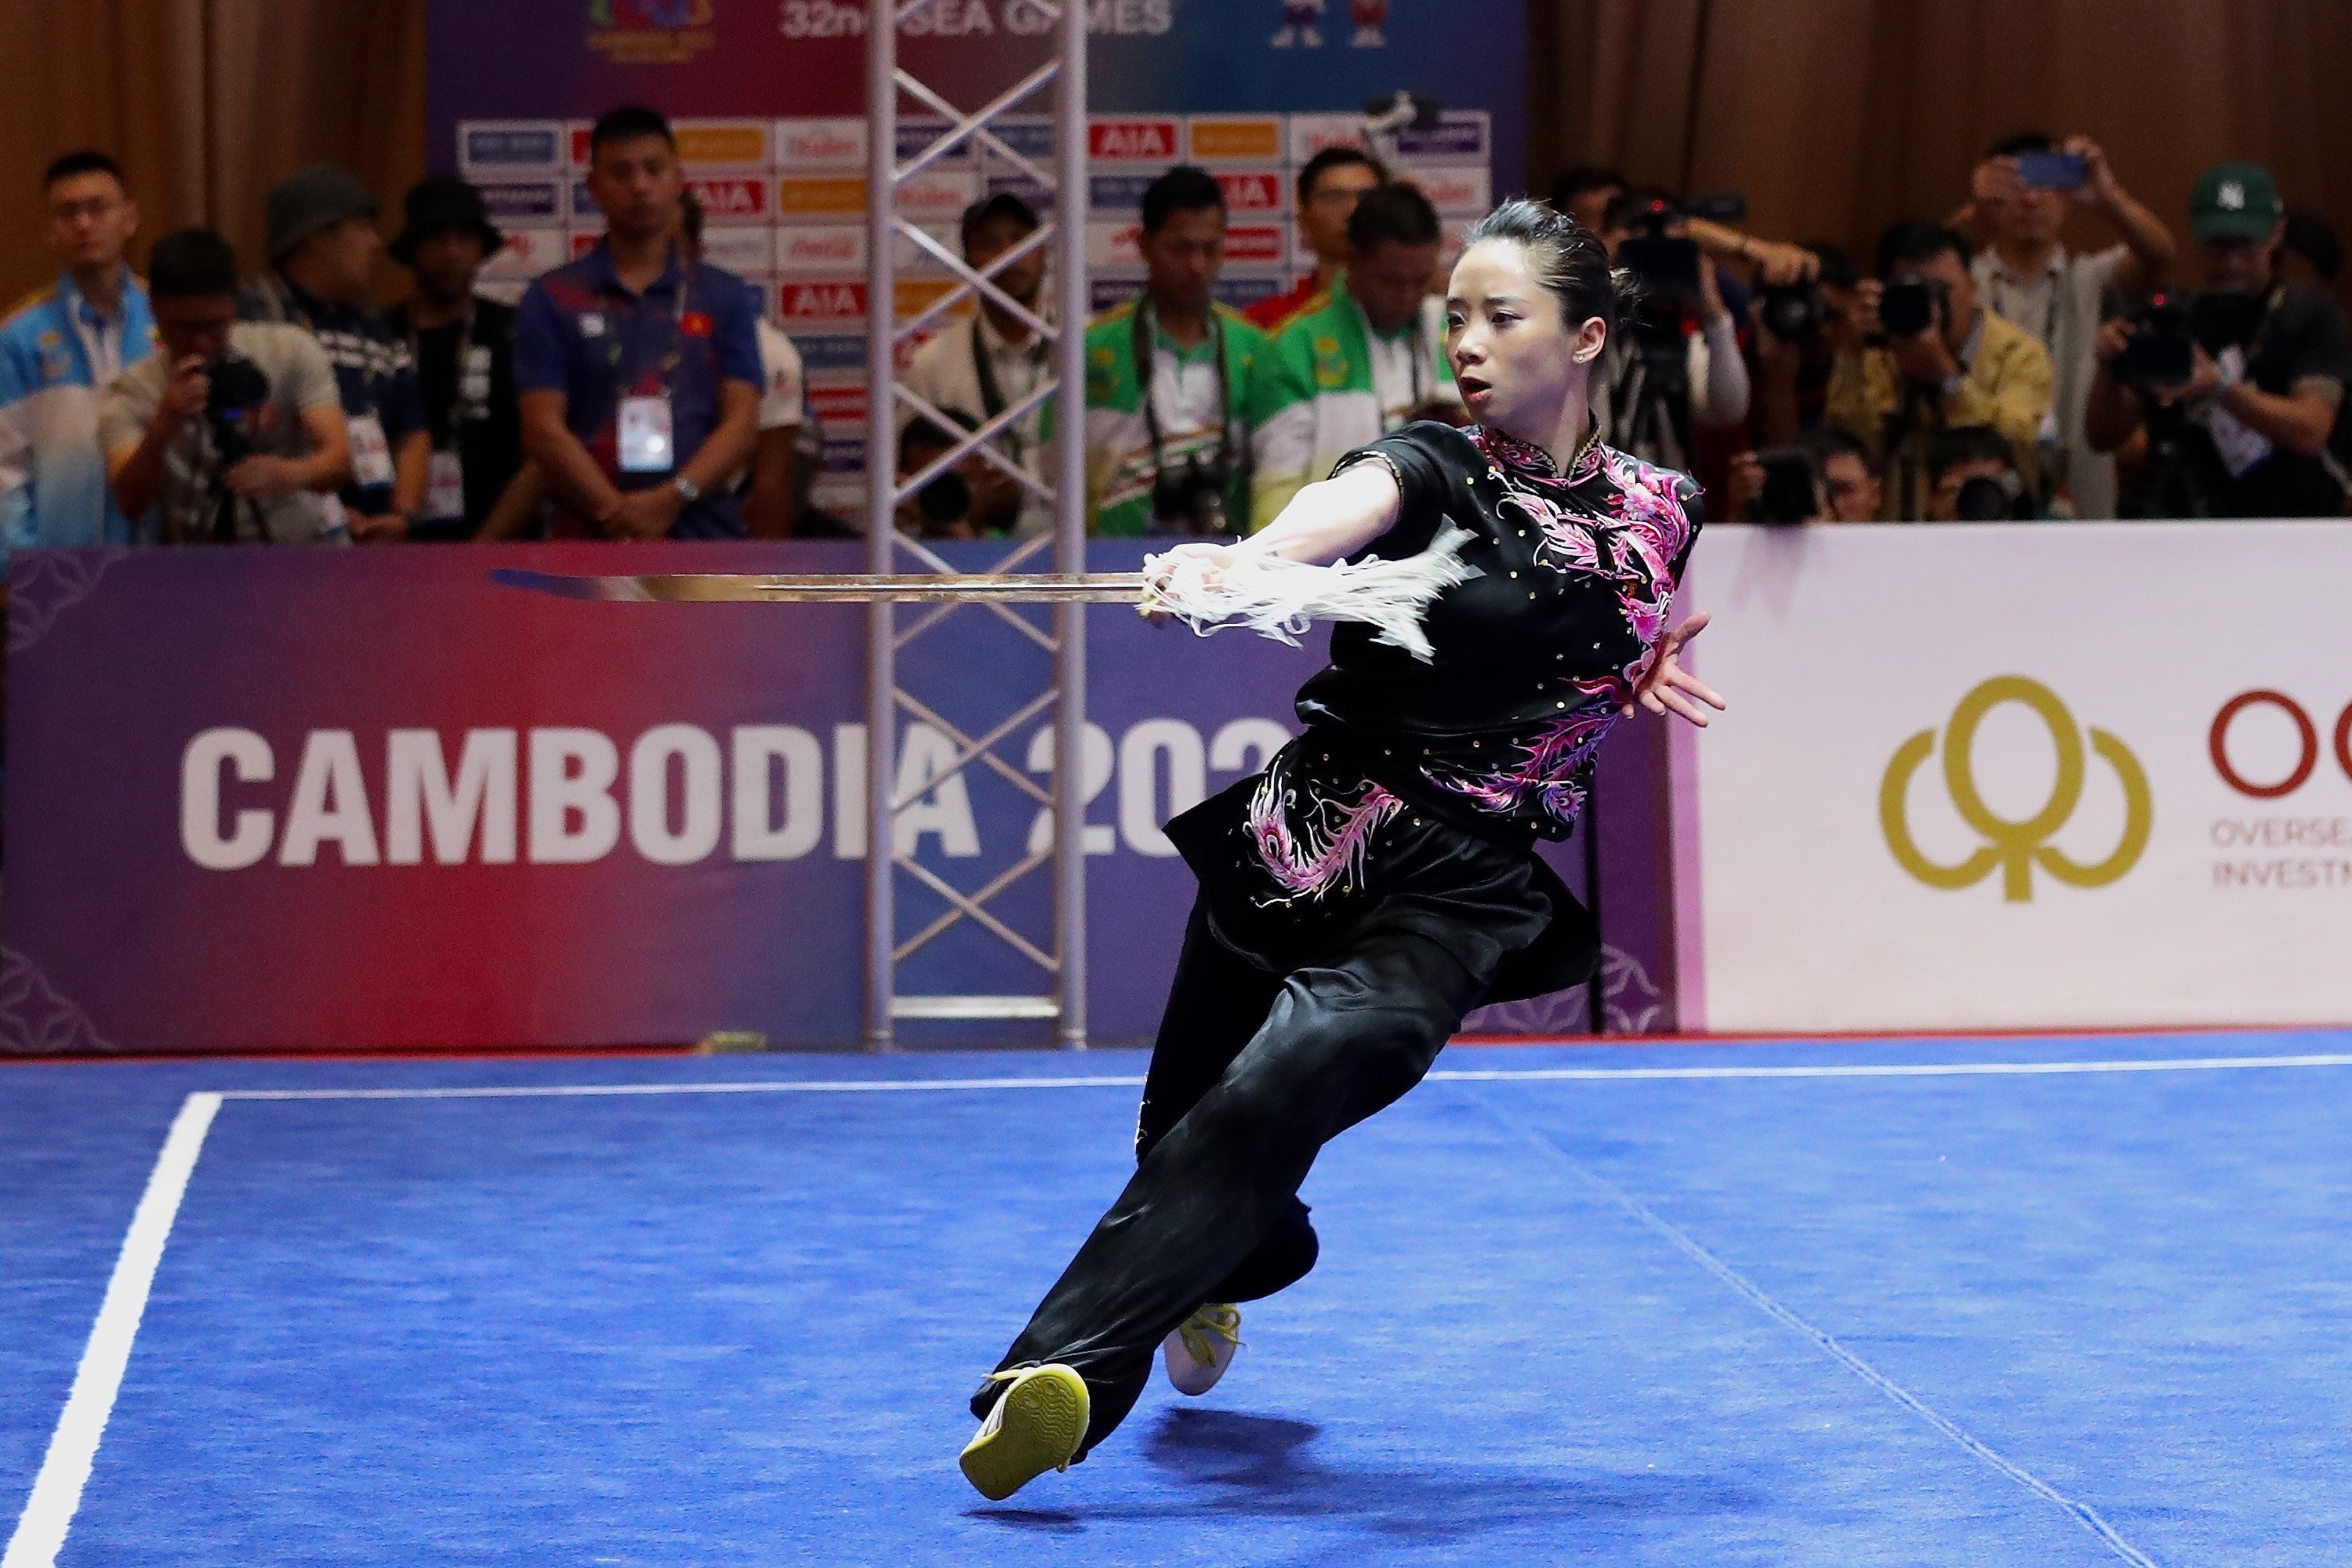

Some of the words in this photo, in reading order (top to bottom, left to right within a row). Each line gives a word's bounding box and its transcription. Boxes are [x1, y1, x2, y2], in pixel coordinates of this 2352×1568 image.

[781, 0, 865, 37] 32n
[901, 0, 994, 36] SEA
[1004, 0, 1172, 36] GMES
[1099, 125, 1167, 154] AIA
[795, 286, 858, 315] AIA
[179, 722, 982, 872] CAMBODIA
